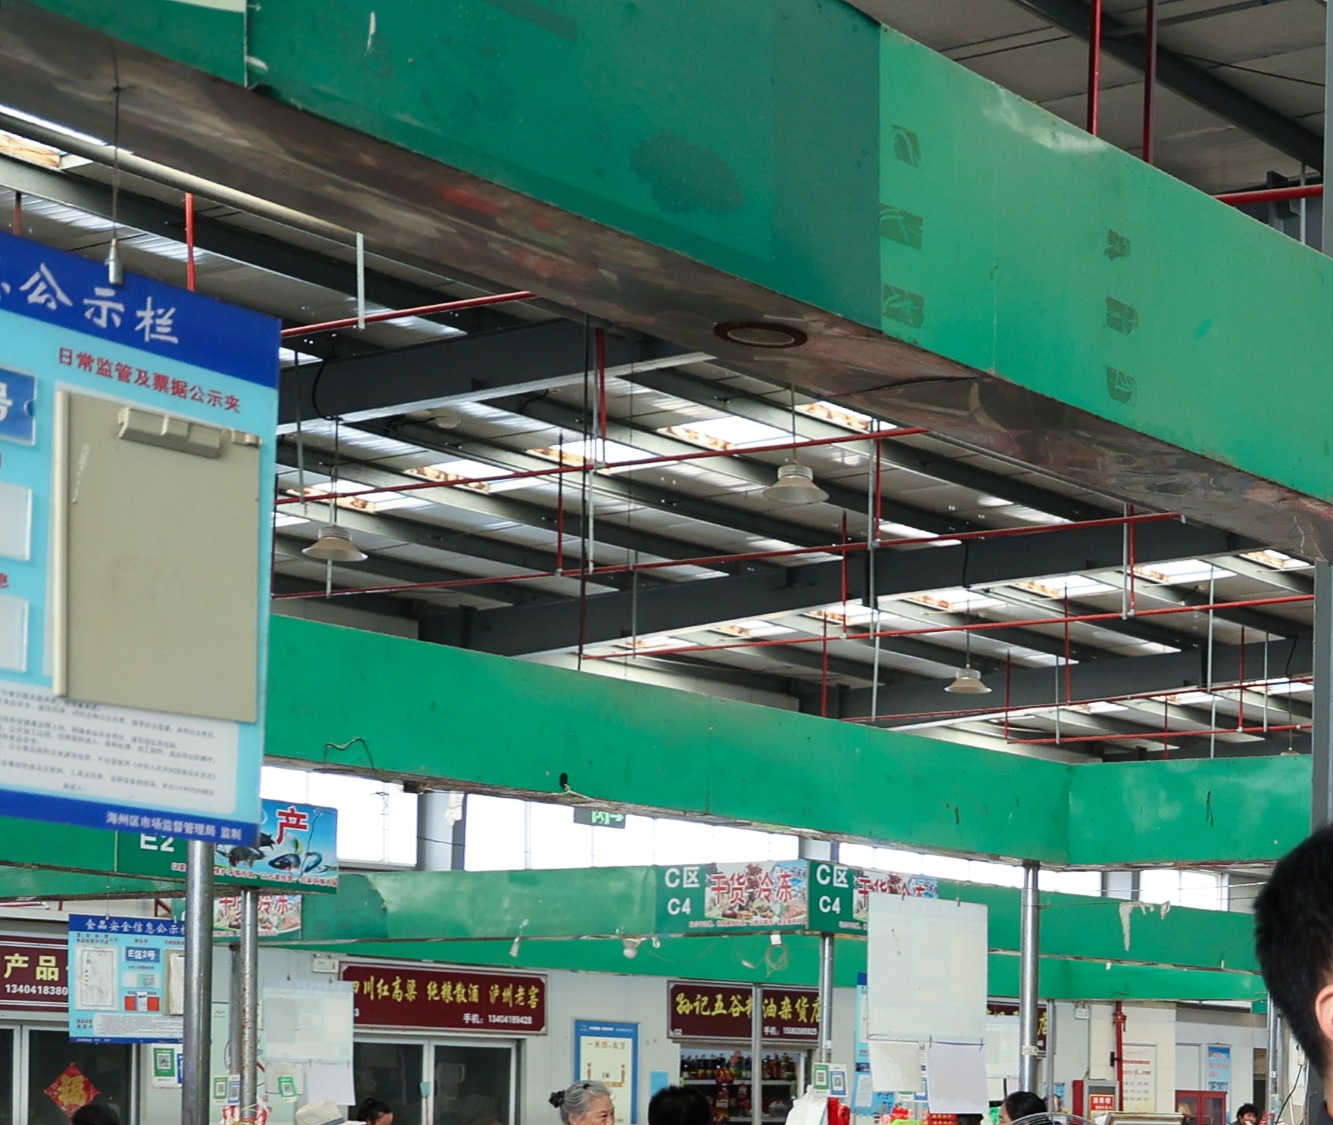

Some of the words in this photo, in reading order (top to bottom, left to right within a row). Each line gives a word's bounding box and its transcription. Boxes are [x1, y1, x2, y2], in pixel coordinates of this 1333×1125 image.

[0, 262, 179, 344] 公示栏
[58, 346, 241, 414] 日常监管及票据公示夹
[105, 810, 217, 838] 海州区市场监督管理局
[220, 824, 243, 841] 监制
[275, 805, 309, 845] 产
[664, 867, 700, 888] C区
[711, 875, 746, 908] 干货
[756, 871, 795, 903] 冷冻
[816, 864, 849, 888] C区
[667, 899, 692, 915] C4
[819, 896, 841, 914] C4
[4, 953, 60, 981] 产品
[127, 949, 158, 960] E区2号
